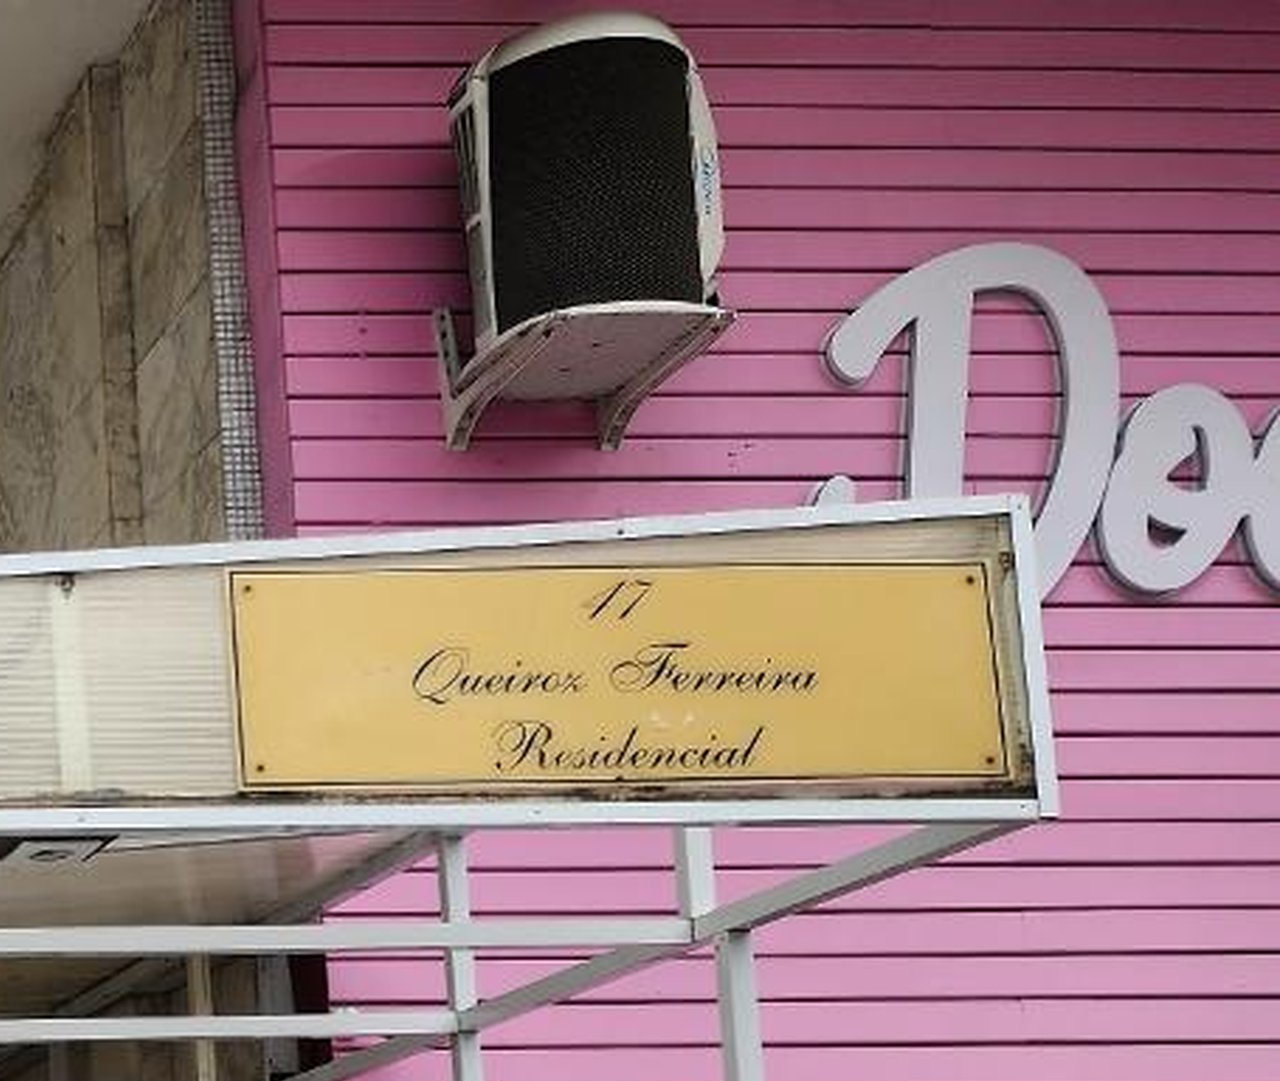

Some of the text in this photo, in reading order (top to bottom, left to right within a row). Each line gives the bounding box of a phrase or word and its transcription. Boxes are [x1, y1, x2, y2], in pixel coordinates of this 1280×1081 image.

[412, 641, 821, 705] Queiroz Ferreira
[493, 719, 765, 771] Residencial
